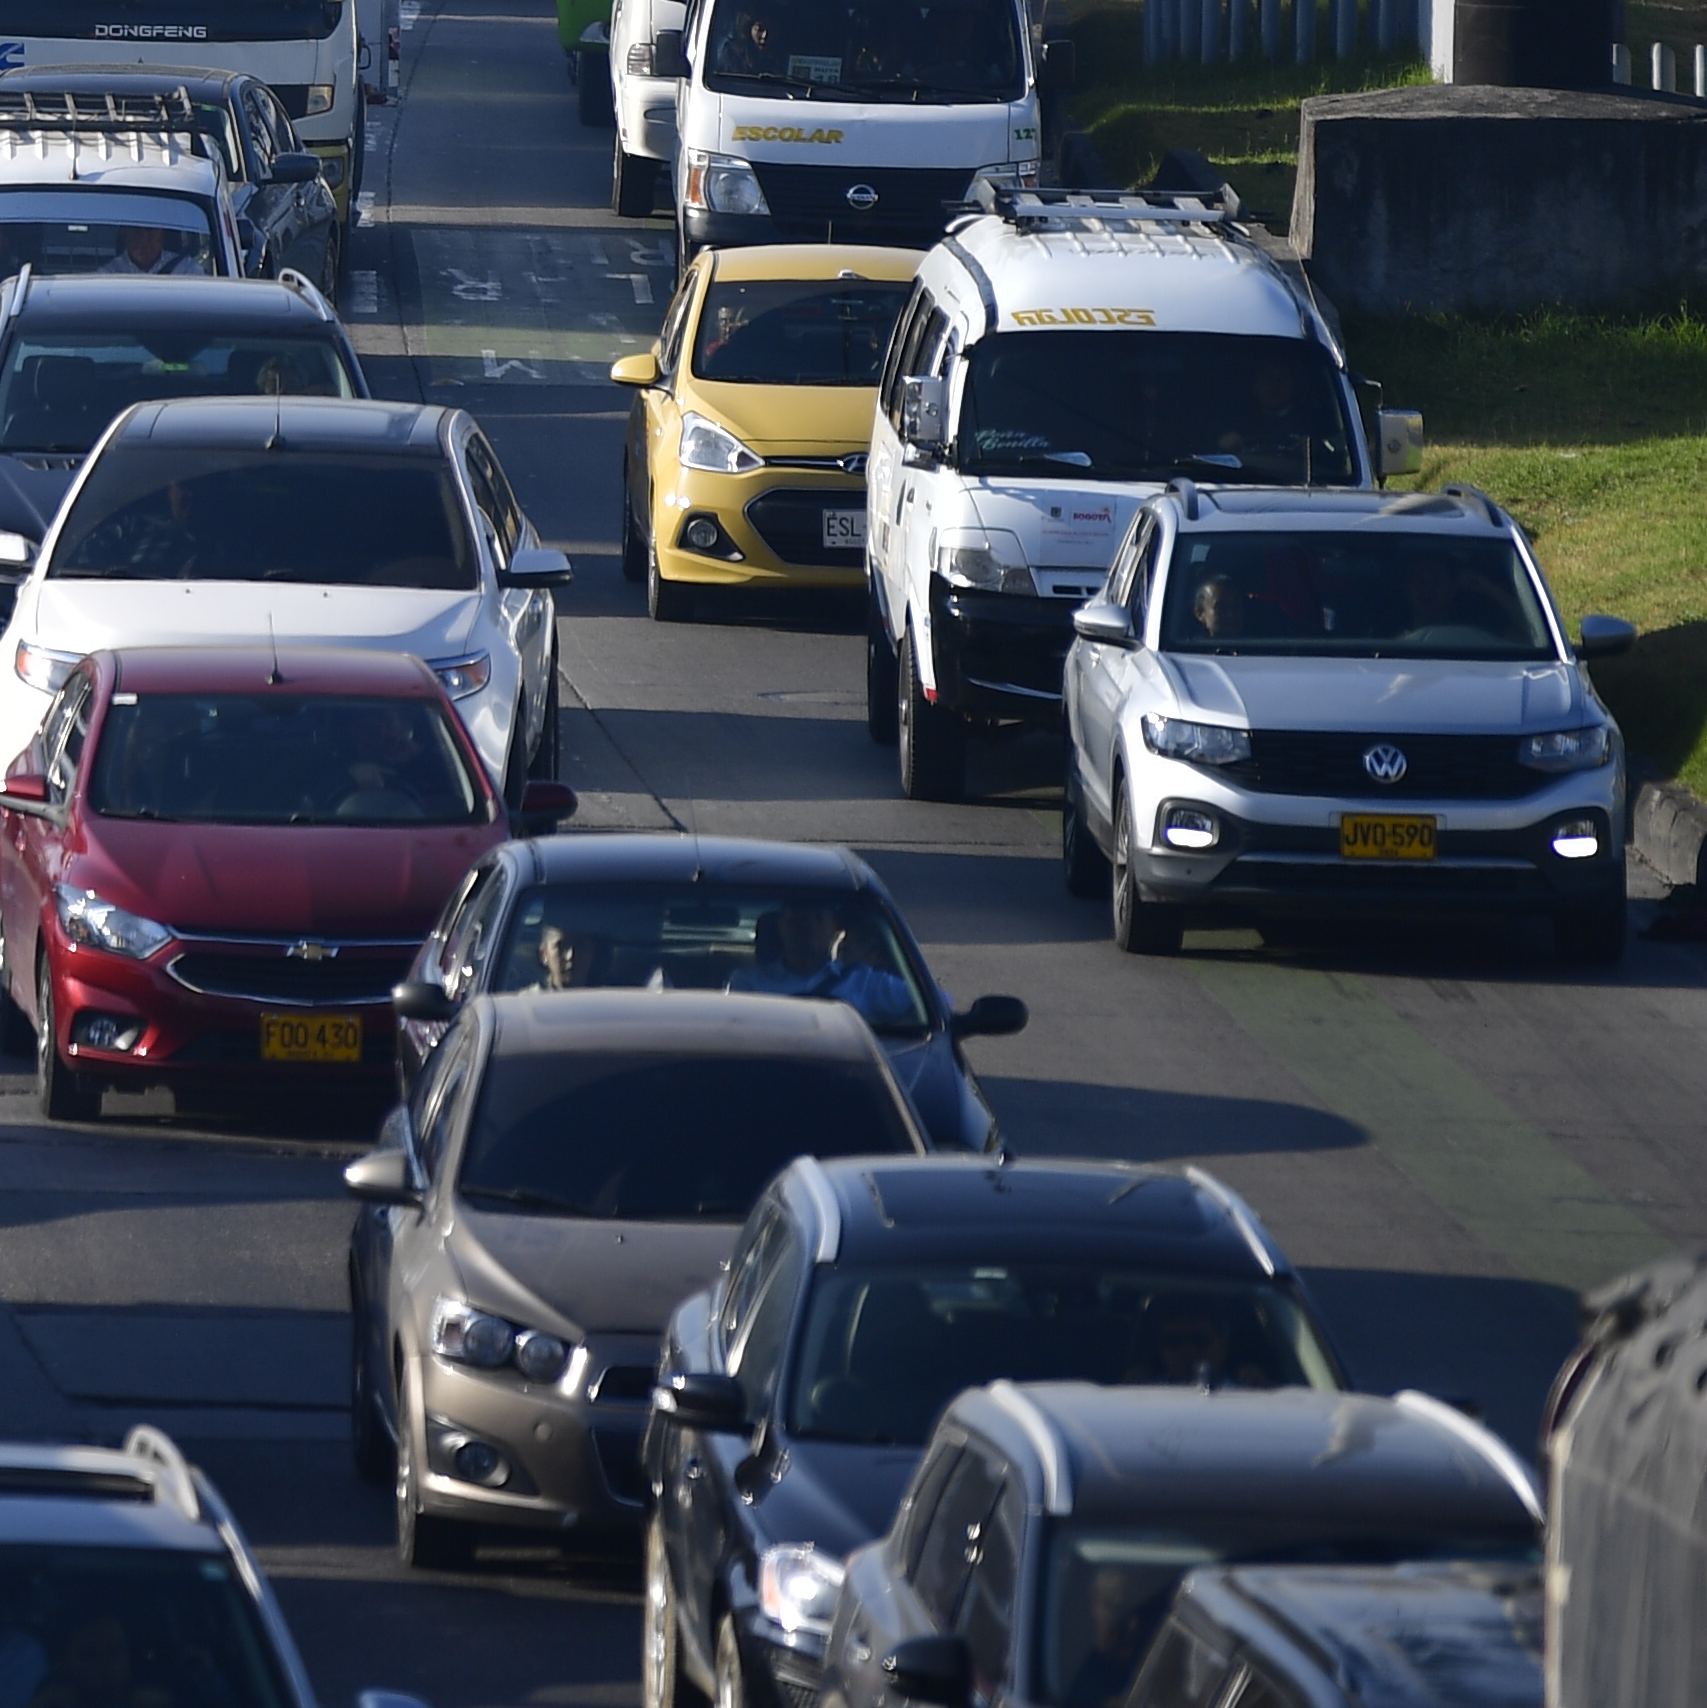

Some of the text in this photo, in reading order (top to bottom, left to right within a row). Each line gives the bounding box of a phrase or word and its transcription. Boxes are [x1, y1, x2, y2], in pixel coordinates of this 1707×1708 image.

[95, 24, 207, 39] DONGFENG
[732, 125, 844, 144] ESCOLAR
[1014, 128, 1036, 140] 12
[826, 514, 867, 538] ESL-
